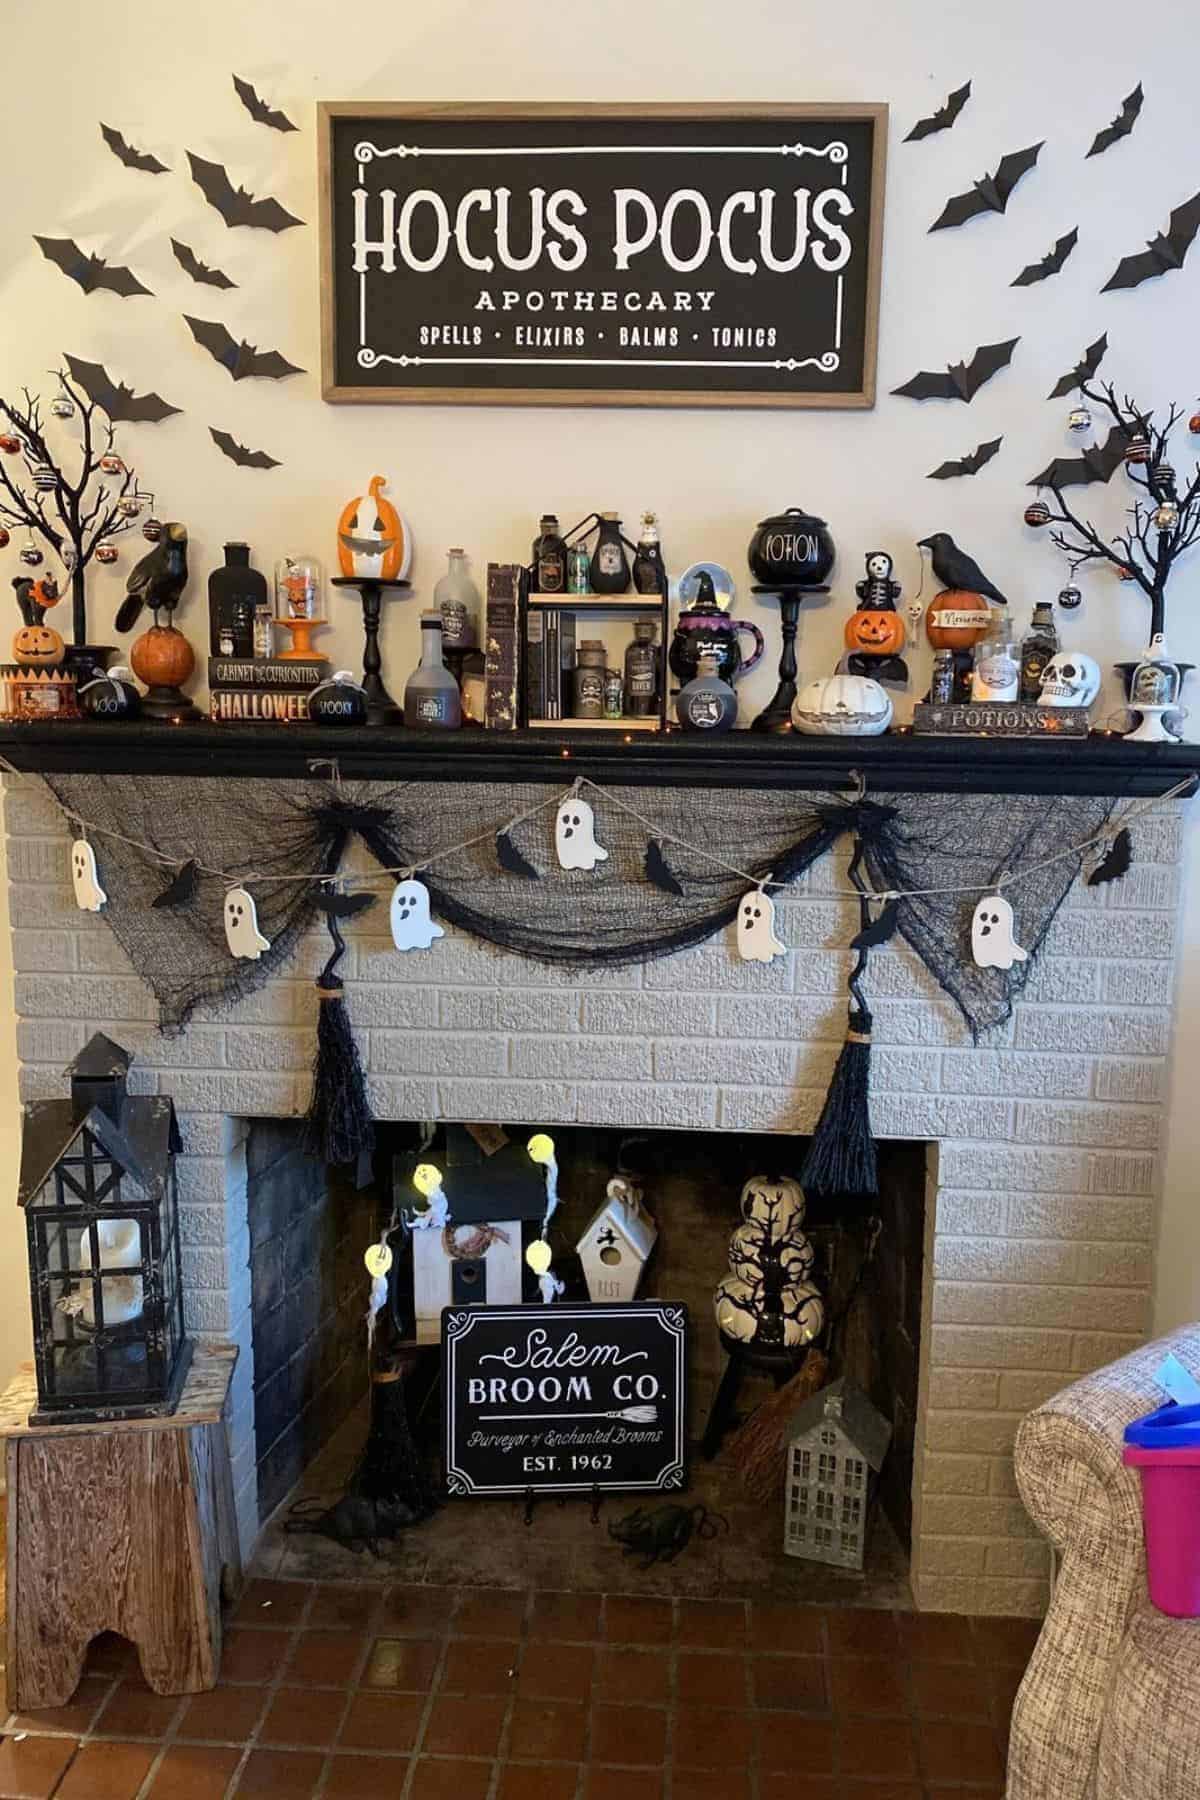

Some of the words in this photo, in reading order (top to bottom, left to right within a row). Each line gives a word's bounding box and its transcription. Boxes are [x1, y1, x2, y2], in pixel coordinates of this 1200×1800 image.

[351, 188, 588, 273] HOCUS
[612, 188, 855, 275] POCUS
[474, 290, 716, 312] APOTHECARY
[419, 325, 482, 346] SPELLS
[515, 325, 586, 347] ELIXIRS
[619, 326, 679, 347] BALMS
[711, 327, 777, 348] TONICS
[216, 664, 254, 683] CABINET
[266, 666, 321, 684] CURIOSITIES
[219, 692, 308, 720] HALLOWEE
[952, 710, 1049, 729] POTIONS
[479, 1328, 649, 1369] Salem
[468, 1376, 593, 1404] BROOM
[612, 1374, 667, 1401] CO.
[467, 1431, 530, 1453] Purveyor
[544, 1425, 615, 1448] Enchanted
[612, 1427, 664, 1445] Brooms
[523, 1456, 561, 1473] EST.
[571, 1455, 612, 1471] 1962
